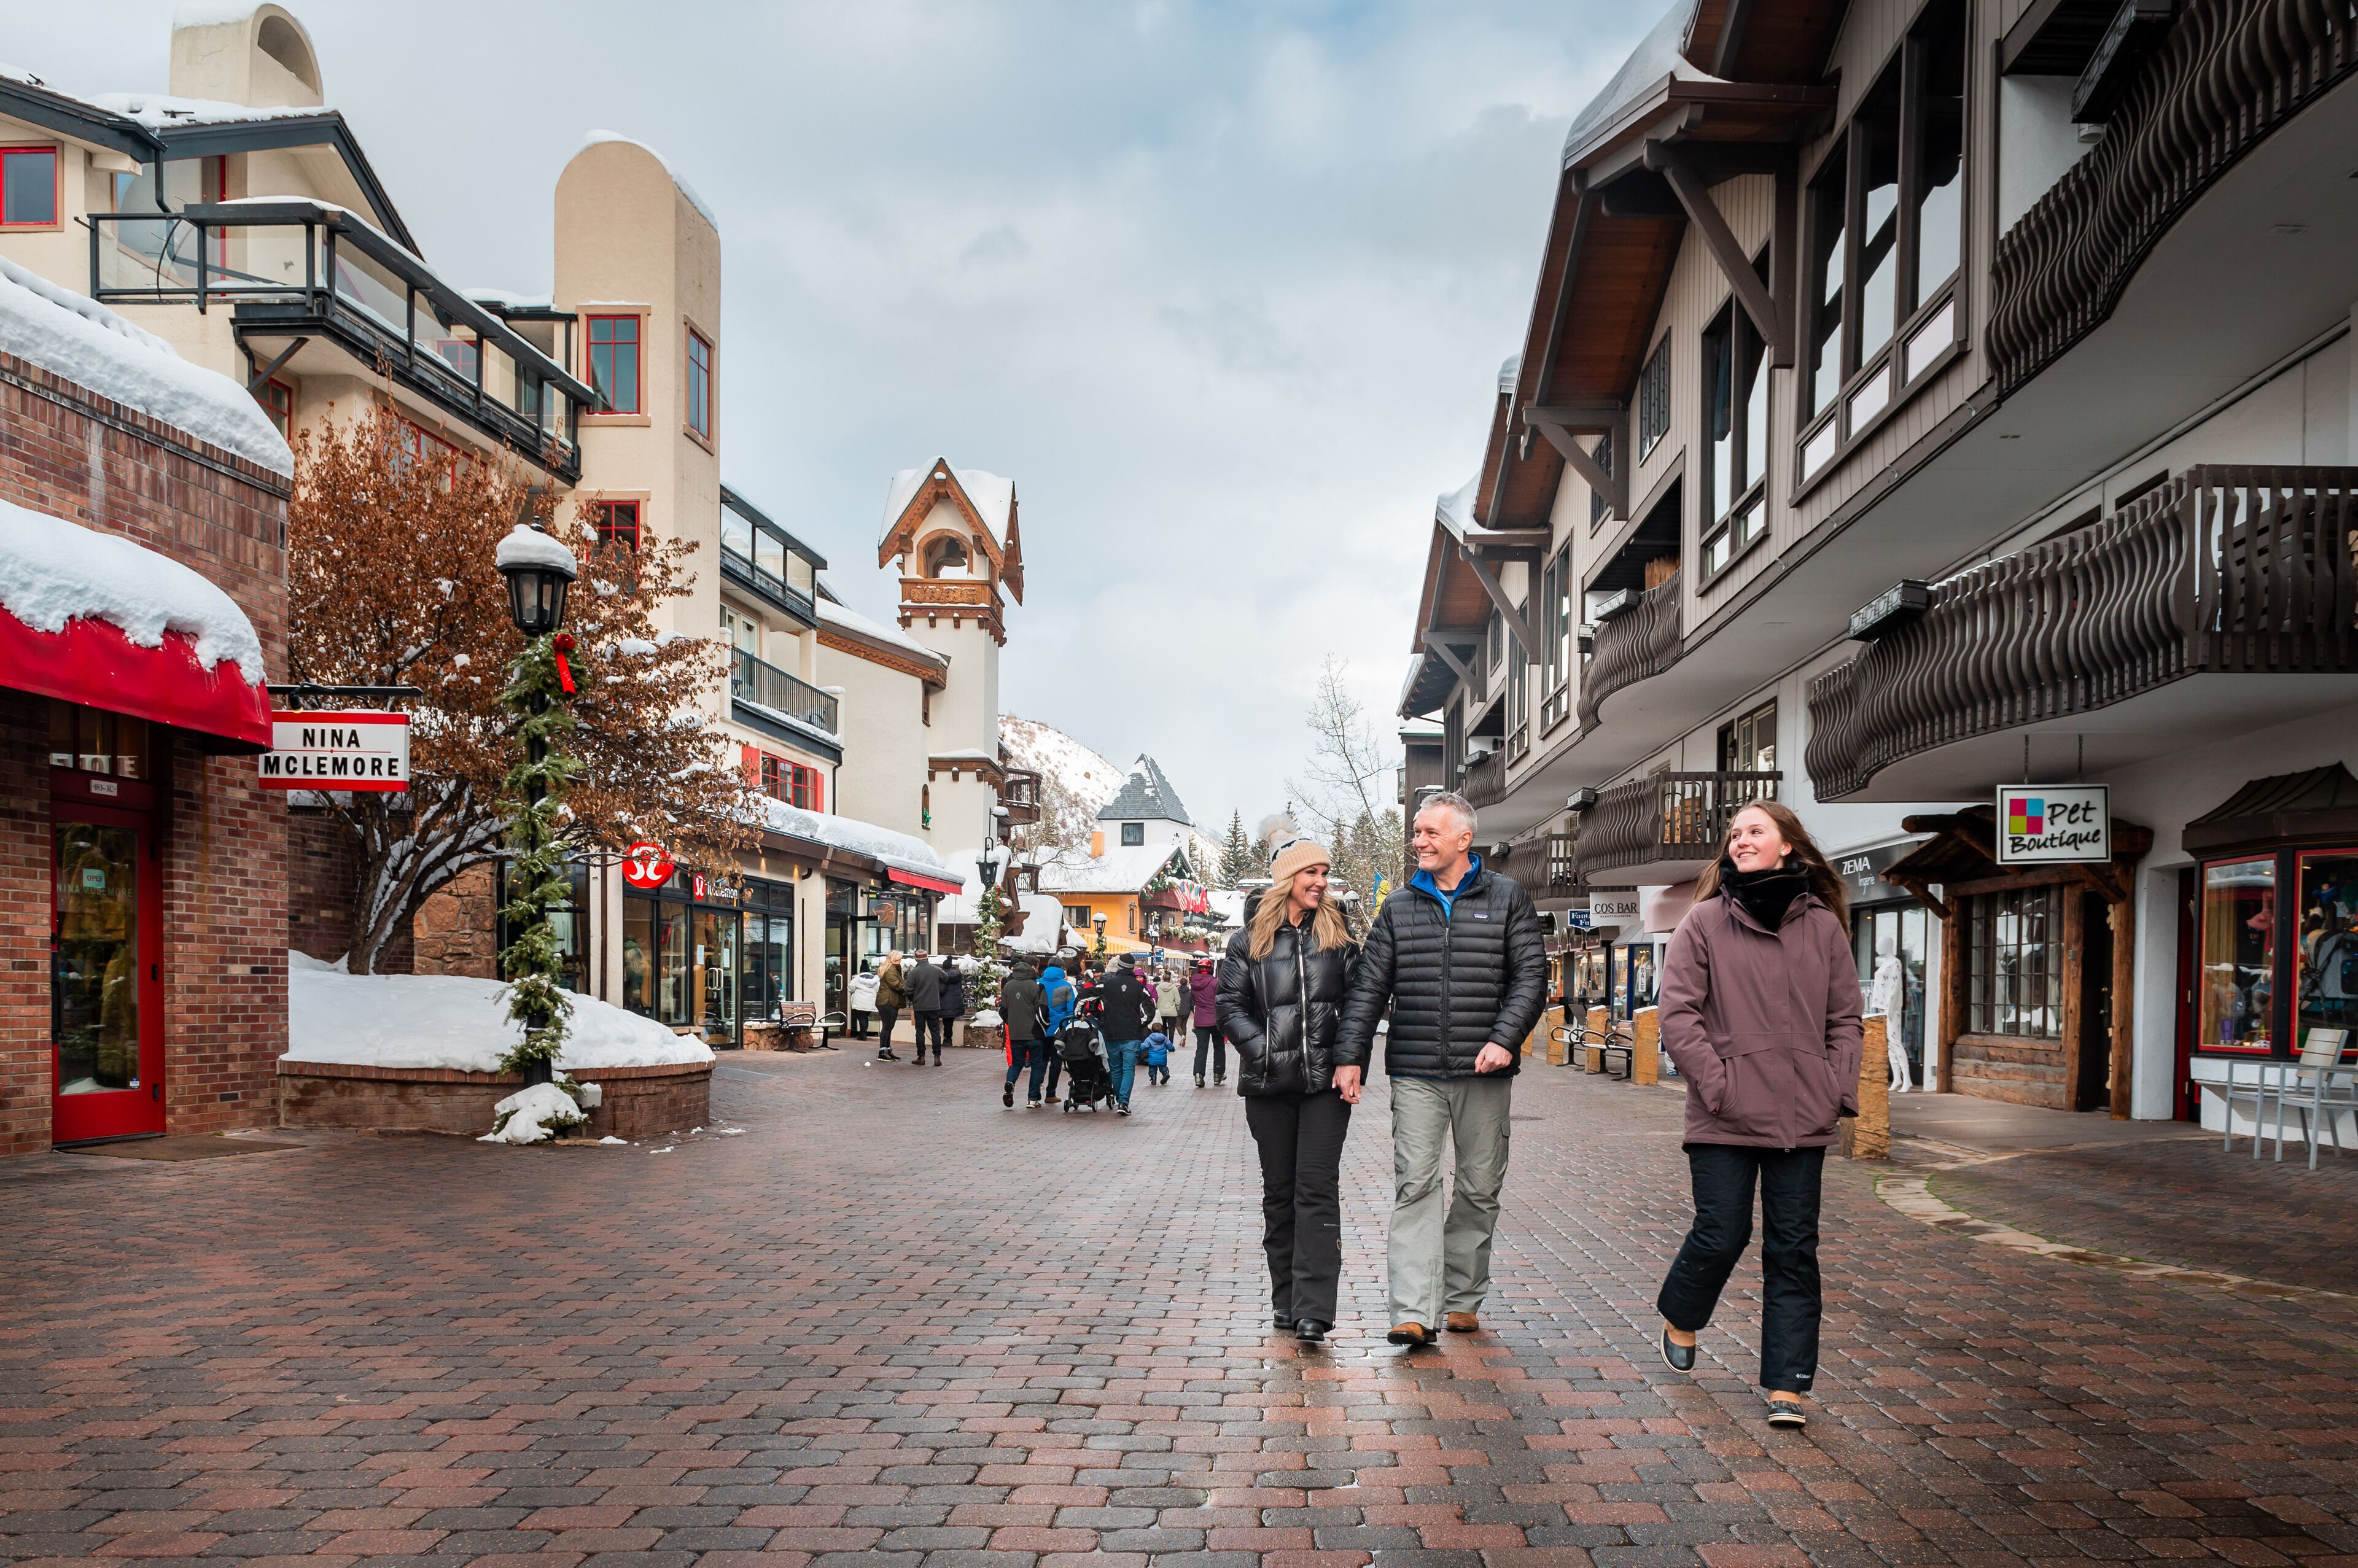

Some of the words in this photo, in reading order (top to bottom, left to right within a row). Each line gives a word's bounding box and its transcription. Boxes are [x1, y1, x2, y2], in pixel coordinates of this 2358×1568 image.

[303, 728, 360, 748] NINA
[263, 755, 399, 777] MCLEMORE
[2047, 800, 2097, 826] Pet
[2008, 828, 2101, 855] Boutique
[1842, 856, 1871, 875] ZEMA
[56, 883, 80, 893] NINA
[1594, 902, 1614, 914] COS
[1617, 902, 1637, 914] BAR
